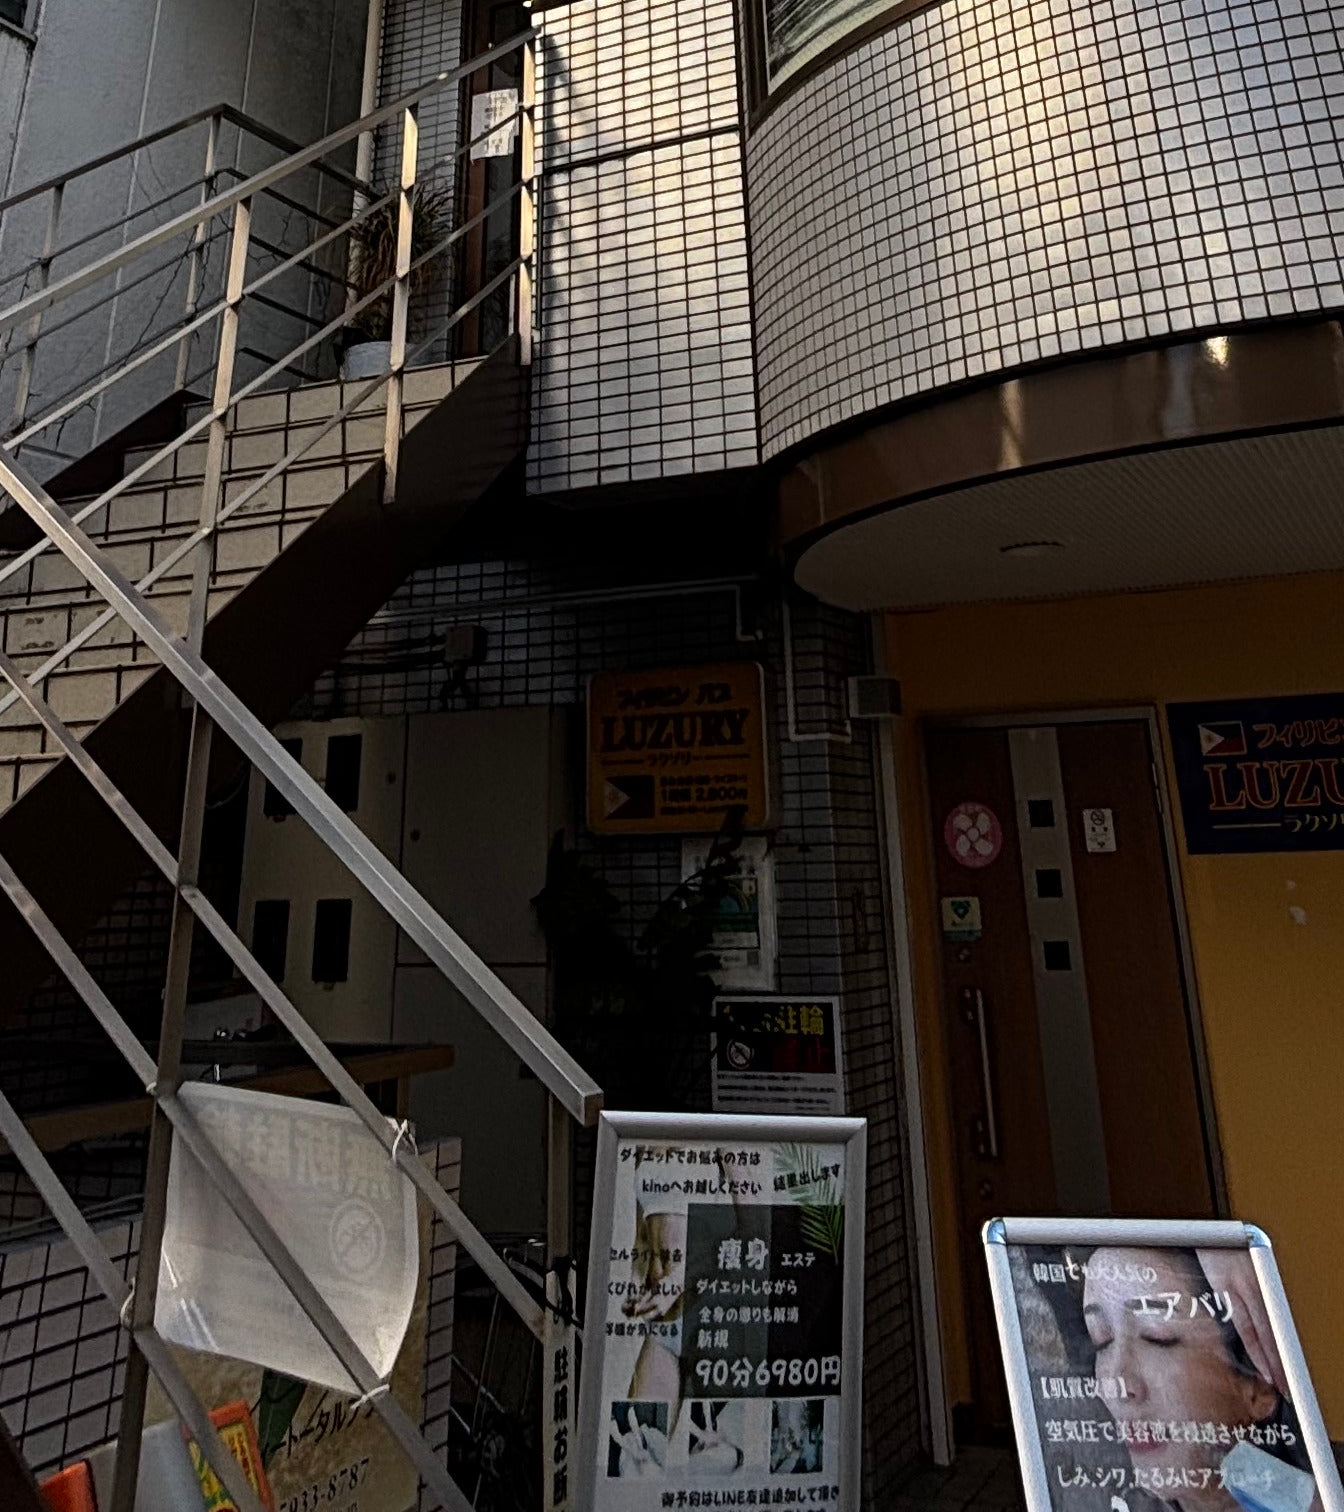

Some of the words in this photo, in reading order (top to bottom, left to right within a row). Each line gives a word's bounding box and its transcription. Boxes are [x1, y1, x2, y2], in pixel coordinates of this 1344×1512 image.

[601, 709, 751, 752] LUZURY
[717, 1237, 769, 1271] 痩身
[780, 1252, 816, 1268] エステ
[696, 1278, 798, 1296] ダイエットしながら
[696, 1329, 729, 1350] 新規
[695, 1354, 842, 1389] 90分6980円
